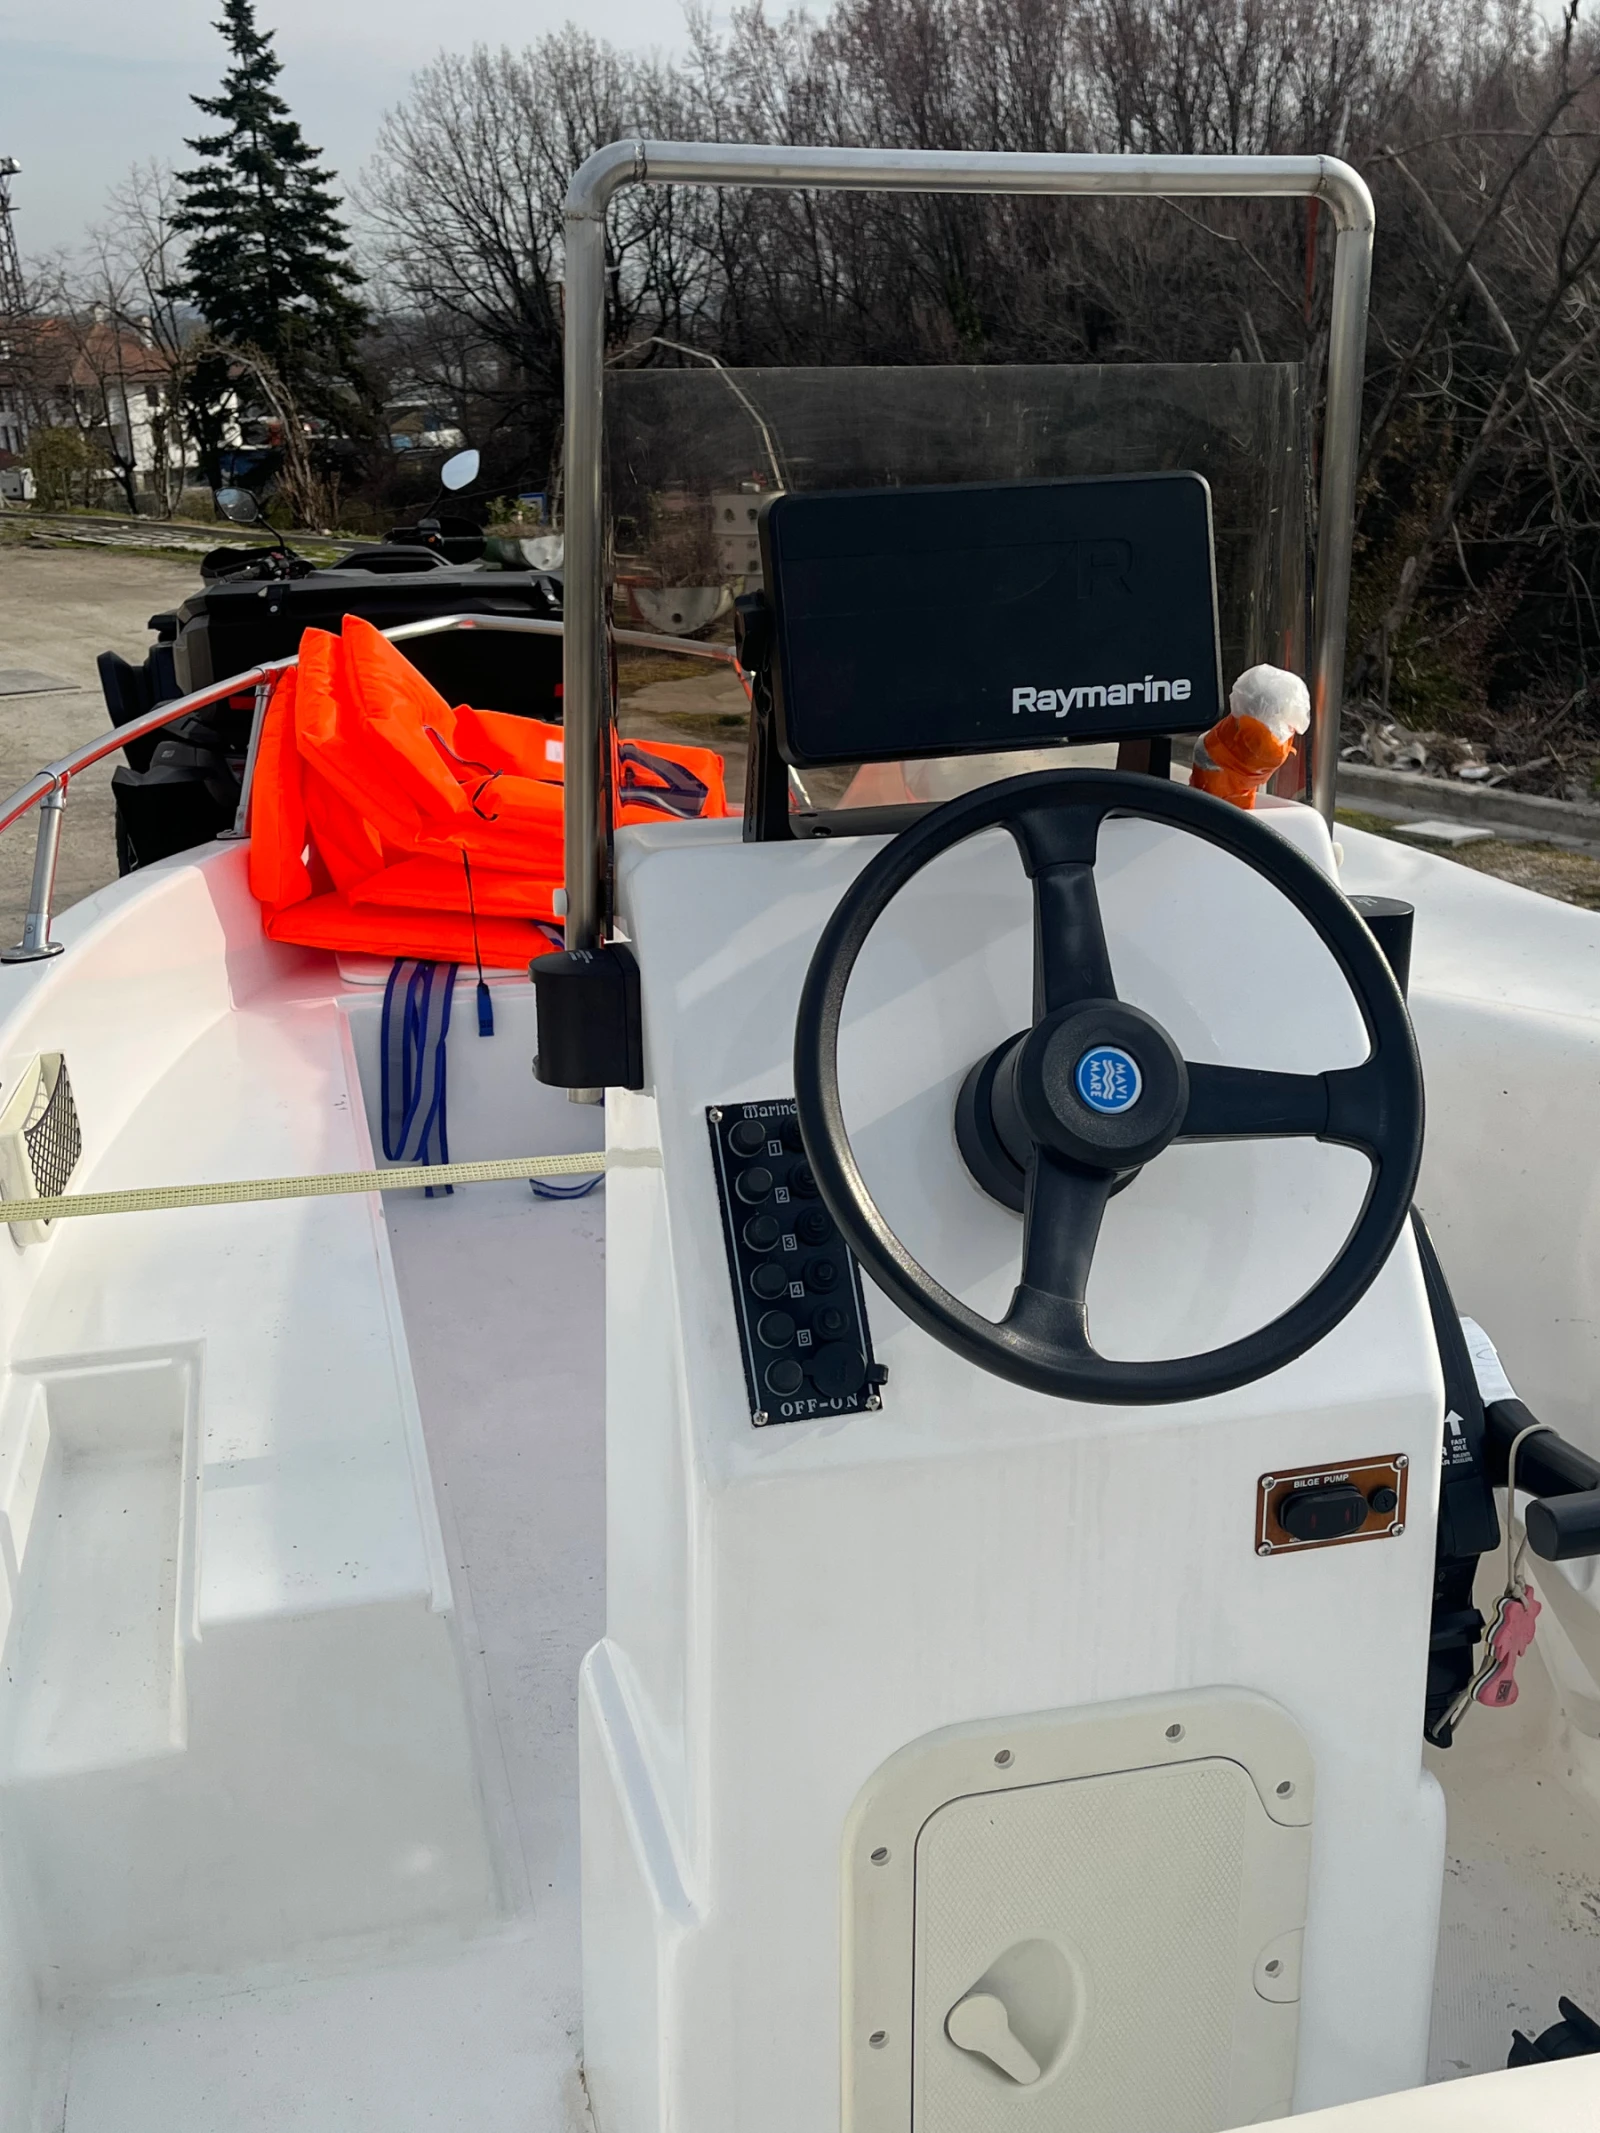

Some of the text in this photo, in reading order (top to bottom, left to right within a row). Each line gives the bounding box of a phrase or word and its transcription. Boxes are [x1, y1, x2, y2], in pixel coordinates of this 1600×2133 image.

[1011, 674, 1192, 718] Raymarine
[1090, 1060, 1102, 1097] MARE
[1115, 1062, 1128, 1099] MAVI
[1450, 1437, 1467, 1446] FAST
[1293, 1473, 1349, 1489] BILGE PUMP
